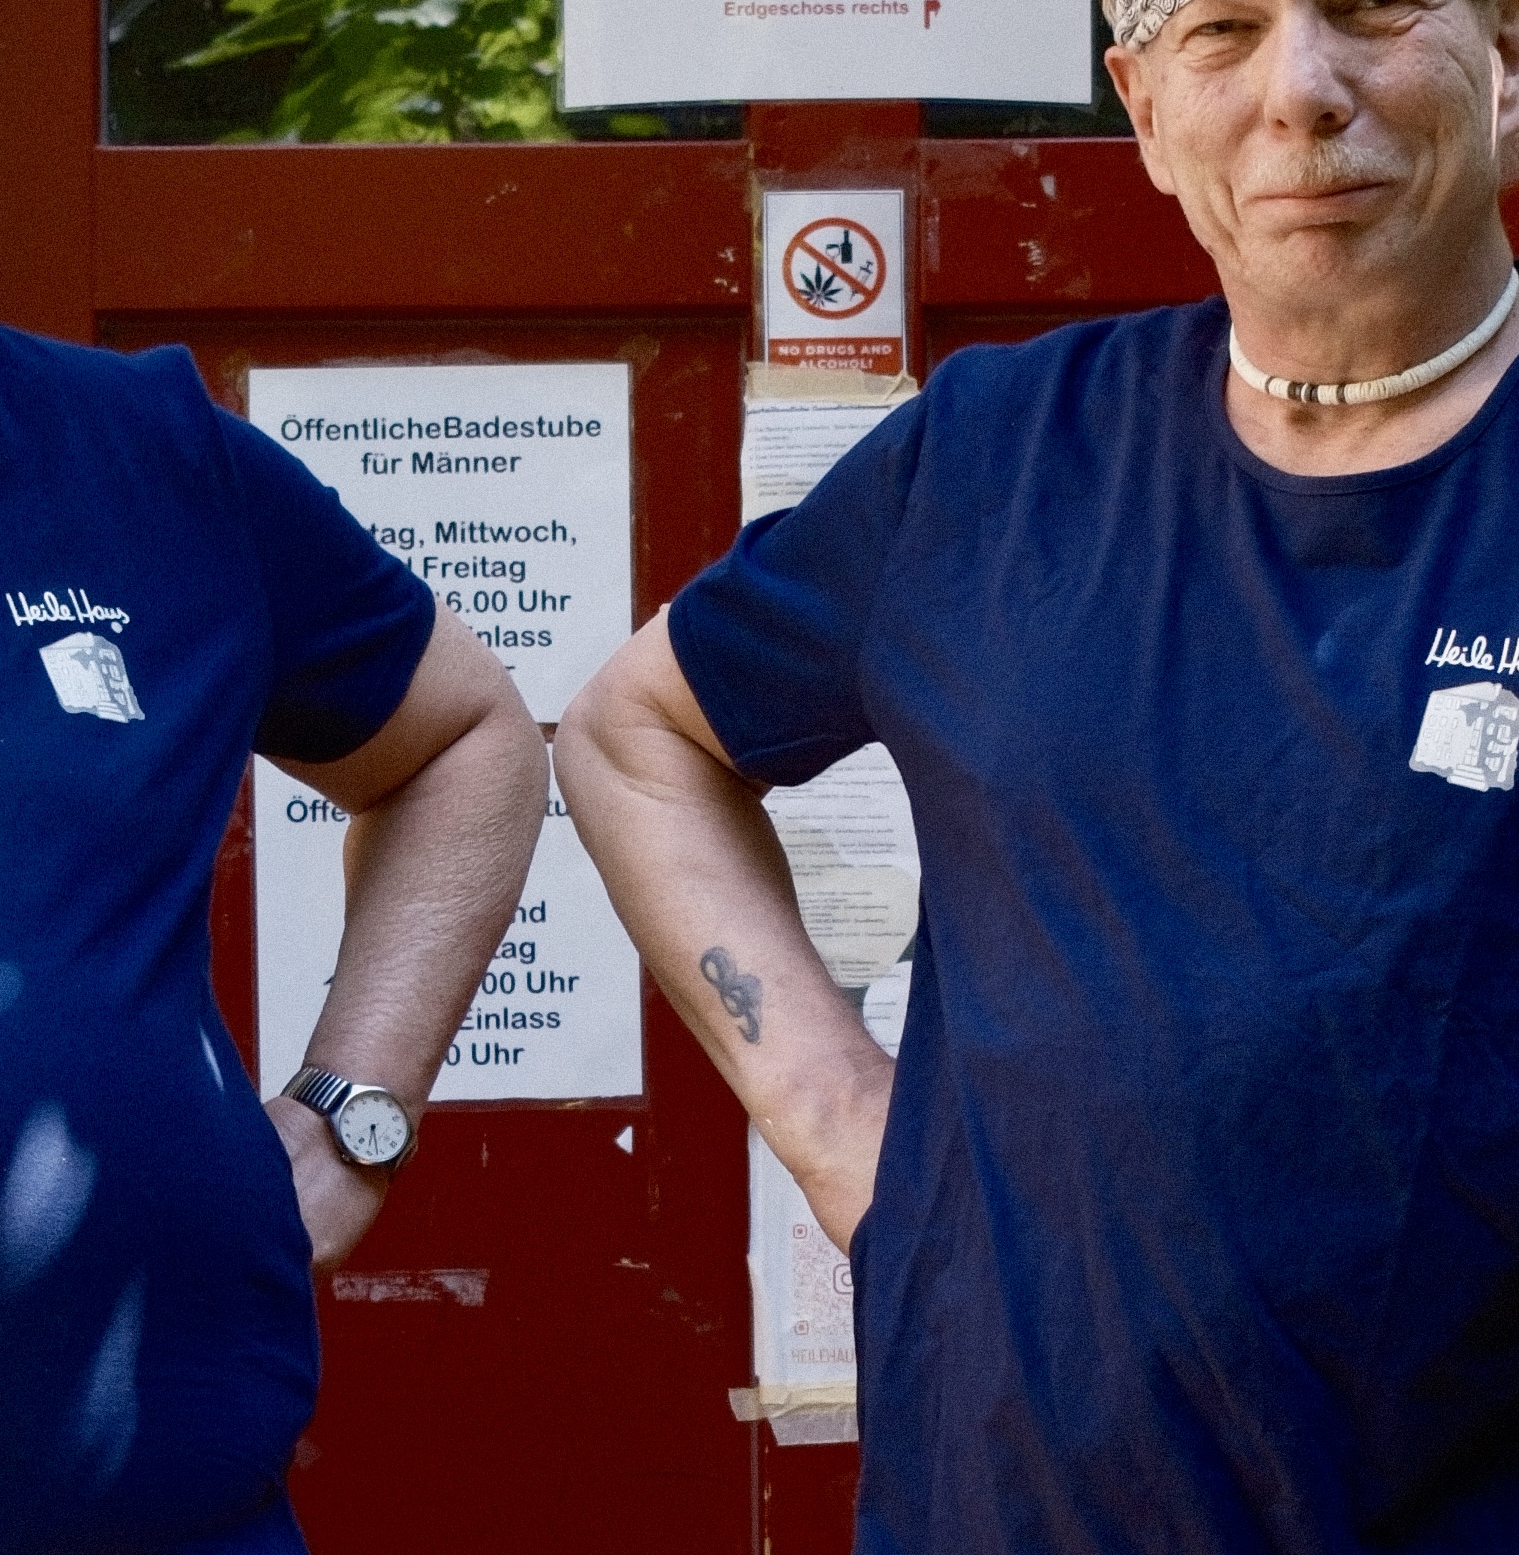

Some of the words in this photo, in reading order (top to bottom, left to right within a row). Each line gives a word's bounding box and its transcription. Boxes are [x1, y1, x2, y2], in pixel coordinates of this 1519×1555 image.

[724, 1, 845, 19] Erdgeschoss
[851, 0, 909, 16] rechts
[778, 345, 801, 356] NO
[805, 345, 856, 356] DRUGS
[861, 345, 893, 356] AND
[361, 452, 402, 475] für
[412, 451, 522, 474] Männer
[369, 522, 425, 550] tag,
[435, 520, 577, 546] Mittwoch,
[423, 556, 526, 584] Freitag
[5, 591, 76, 627] Heile
[518, 589, 571, 612] Uhr
[1425, 628, 1495, 671] Heile
[526, 970, 579, 994] Uhr
[471, 1042, 525, 1065] Uhr
